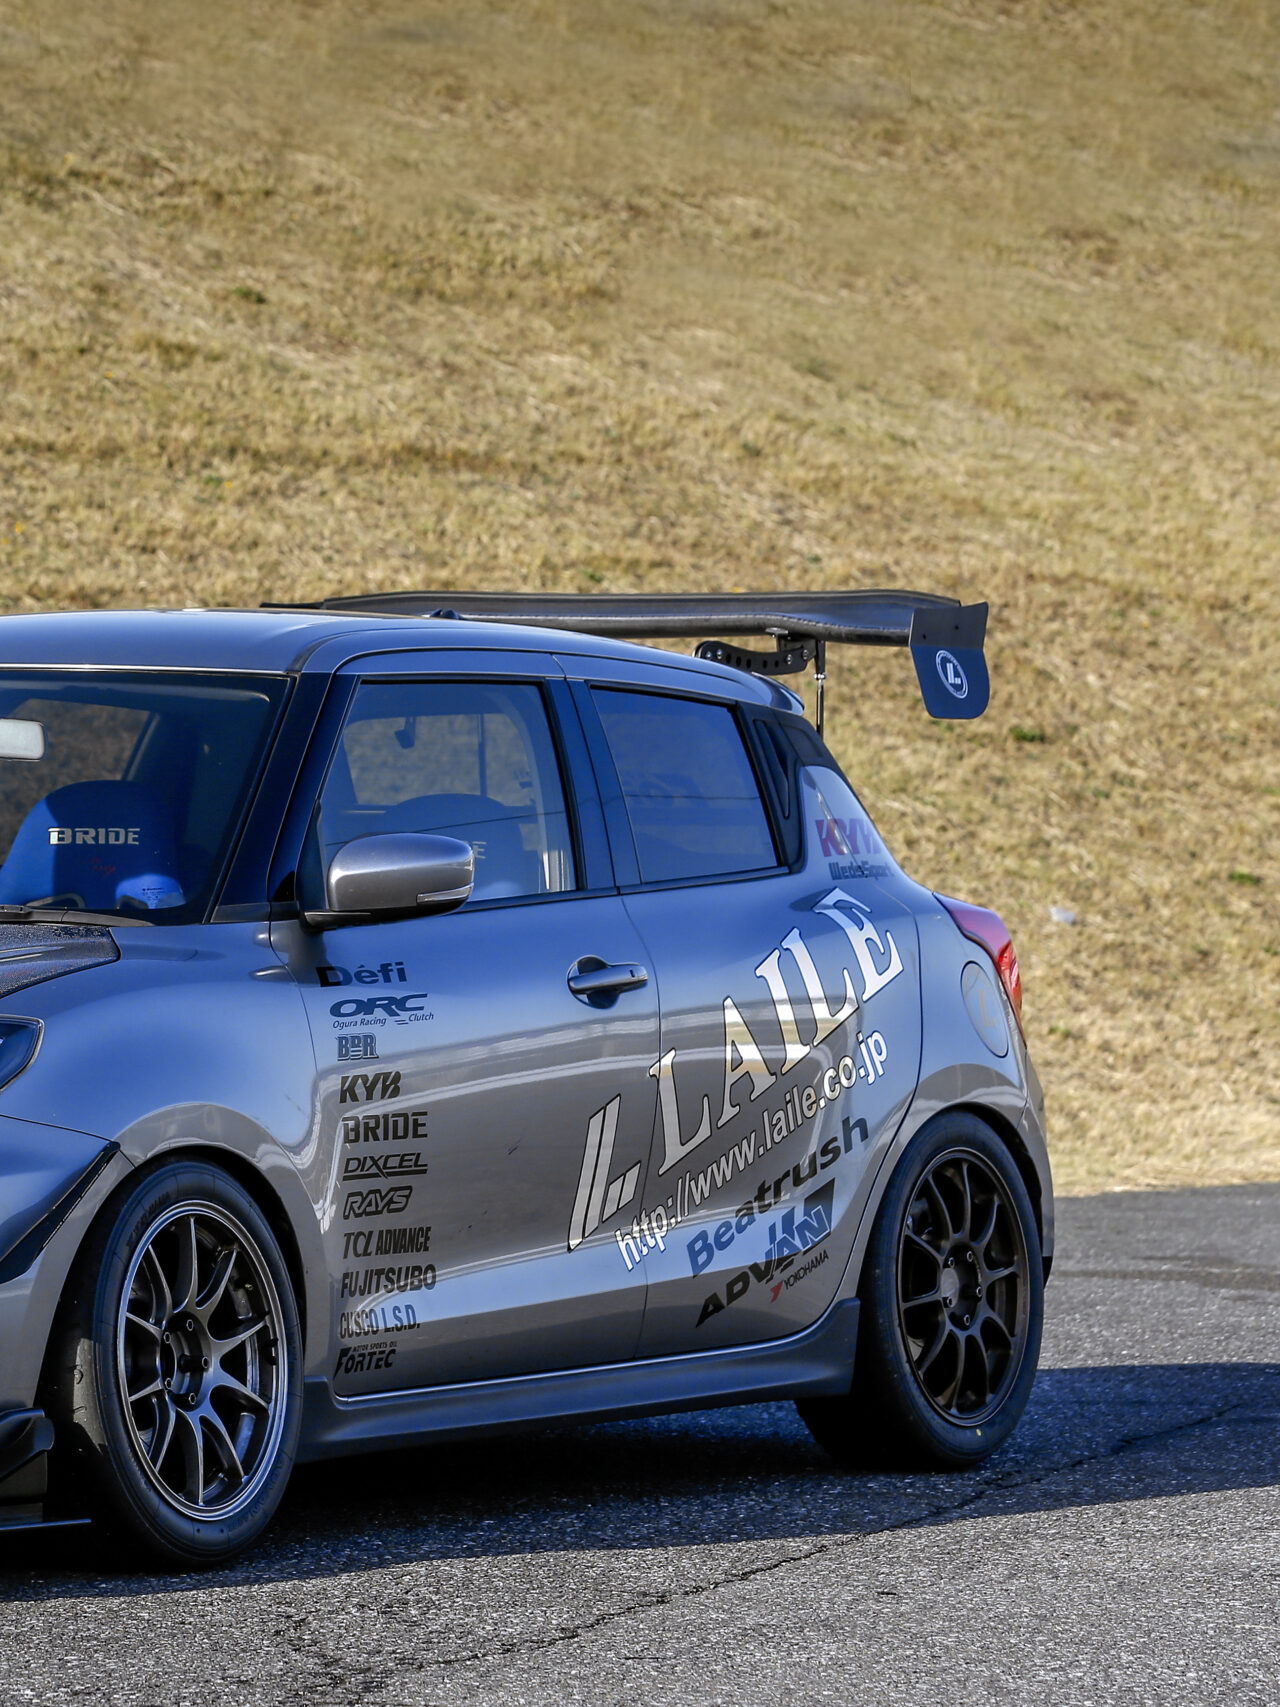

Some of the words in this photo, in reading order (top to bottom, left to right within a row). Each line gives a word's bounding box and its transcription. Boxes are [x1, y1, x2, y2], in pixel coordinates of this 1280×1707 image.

[48, 827, 140, 845] BRIDE
[329, 993, 428, 1018] ORC
[332, 1019, 358, 1030] Ogura
[359, 1017, 387, 1028] Racing
[408, 1012, 435, 1023] Clutch
[647, 886, 905, 1177] LAILE
[339, 1071, 402, 1104] KYB
[341, 1111, 429, 1144] BRIDE
[343, 1152, 429, 1179] DIXCEL
[615, 1029, 889, 1272] http://www.laile.co.jp
[343, 1185, 413, 1220] RAYS
[686, 1114, 869, 1279] Beatrush
[375, 1226, 432, 1255] ADVANCE
[695, 1178, 836, 1329] ADVAN
[340, 1263, 437, 1298] FUJITSUBO
[784, 1249, 829, 1290] YOKOHAMA
[339, 1309, 380, 1339] CUSCO
[333, 1347, 397, 1380] FORTEC
